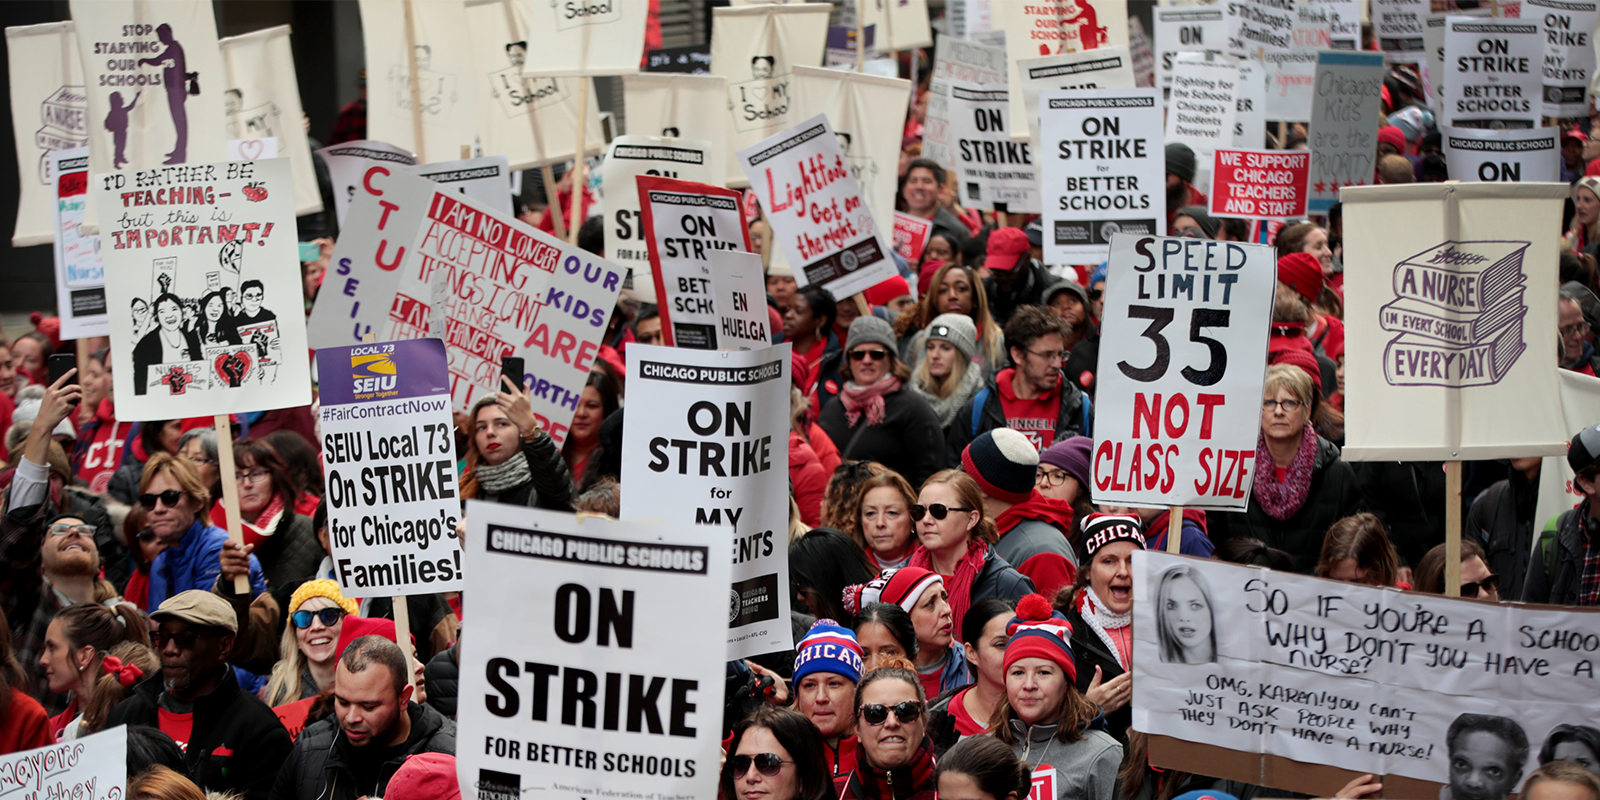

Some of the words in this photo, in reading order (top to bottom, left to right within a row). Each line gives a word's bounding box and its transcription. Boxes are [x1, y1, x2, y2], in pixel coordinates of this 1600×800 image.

[564, 1, 612, 19] School
[1024, 5, 1076, 16] STARVING
[122, 24, 153, 37] STOP
[1035, 19, 1059, 29] OUR
[1544, 13, 1571, 31] ON
[1180, 26, 1203, 45] ON
[1477, 39, 1508, 55] ON
[94, 41, 160, 54] STARVING
[107, 59, 136, 71] OUR
[1457, 57, 1530, 74] STRIKE
[1544, 54, 1566, 68] MY
[99, 73, 162, 87] SCHOOLS
[1463, 85, 1523, 98] BETTER
[509, 79, 559, 106] School
[740, 86, 747, 102] I
[771, 82, 789, 99] MY
[1050, 98, 1085, 108] CHICAGO
[1115, 97, 1154, 107] SCHOOLS
[743, 97, 791, 121] School
[1325, 98, 1361, 122] Kids
[1457, 100, 1531, 113] SCHOOLS
[975, 108, 1003, 132] ON
[1082, 117, 1120, 136] ON
[1058, 139, 1147, 160] STRIKE
[1345, 127, 1371, 149] the
[1450, 138, 1483, 149] CHICAGO
[1484, 141, 1515, 150] PUBLIC
[1516, 139, 1554, 150] SCHOOLS
[615, 145, 649, 158] CHICAGO
[649, 147, 676, 161] PUBLIC
[675, 149, 703, 163] SCHOOLS
[750, 145, 780, 165] CHICAGO
[959, 138, 1033, 166] STRIKE
[1220, 152, 1242, 167] WE
[1246, 153, 1307, 169] SUPPORT
[104, 173, 126, 190] I'D
[136, 165, 216, 188] RATHER
[227, 162, 254, 180] BE
[459, 168, 498, 179] SCHOOLS
[1067, 176, 1139, 191] BETTER
[1233, 169, 1294, 185] CHICAGO
[1478, 162, 1521, 182] ON
[765, 152, 848, 217] Lightfoot
[1228, 183, 1297, 201] TEACHERS
[652, 193, 680, 205] CHICAGO
[680, 195, 705, 206] PUBLIC
[705, 197, 736, 210] SCHOOLS
[811, 197, 842, 225] Get
[844, 195, 861, 213] on
[1059, 194, 1151, 211] SCHOOLS
[1224, 199, 1255, 215] AND
[1258, 201, 1297, 216] STAFF
[117, 211, 154, 229] but
[162, 208, 200, 225] this
[211, 206, 233, 222] is
[681, 214, 717, 237] ON
[112, 222, 275, 251] IMPORTANT!
[443, 201, 478, 229] AM
[480, 211, 504, 242] NO
[506, 229, 562, 274] LONGER
[420, 221, 533, 291] ACCEPTING
[617, 248, 633, 260] FOR
[1133, 237, 1247, 272] SPEED
[564, 255, 620, 293] OUR
[1138, 274, 1238, 305] LIMIT
[1401, 268, 1418, 295] A
[1422, 270, 1476, 308] NURSE
[500, 290, 550, 333] CAN'T
[545, 286, 605, 328] KIDS
[732, 291, 748, 312] EN
[721, 315, 767, 342] HUELGA
[1385, 312, 1398, 325] IN
[1402, 314, 1433, 332] EVERY
[1434, 322, 1468, 342] SCHOOL
[351, 346, 380, 356] LOCAL
[382, 344, 395, 353] 73
[523, 322, 598, 374] ARE
[1117, 304, 1231, 387] 35
[643, 363, 698, 380] CHICAGO
[699, 369, 747, 382] PUBLIC
[748, 363, 779, 381] SCHOOLS
[1395, 349, 1458, 379] EVERY
[1459, 347, 1489, 379] DAY
[353, 375, 397, 394] SEIU
[354, 391, 375, 400] Stronger
[376, 389, 399, 399] Together
[322, 400, 447, 422] #FairContractNow
[687, 401, 752, 437] ON
[1132, 392, 1225, 440] NOT
[325, 431, 362, 465] SEIU
[367, 426, 418, 461] Local
[423, 423, 451, 455] 73
[648, 435, 771, 478] STRIKE
[1094, 440, 1180, 494] CLASS
[1194, 447, 1255, 499] SIZE
[329, 469, 357, 509] On
[362, 460, 455, 507] STRIKE
[710, 486, 733, 500] for
[332, 518, 355, 549] for
[361, 509, 458, 550] Chicago's
[695, 507, 744, 534] MY
[490, 529, 565, 558] CHICAGO
[565, 537, 626, 565] PUBLIC
[626, 545, 706, 571] SCHOOLS
[338, 550, 462, 588] Families!
[741, 595, 769, 607] TEACHERS
[1244, 578, 1289, 616] SO
[1317, 594, 1344, 618] IF
[1363, 602, 1449, 636] YOU'RE
[1466, 619, 1487, 642] A
[554, 582, 635, 649] ON
[1265, 621, 1328, 655] WHY
[1344, 632, 1416, 666] DON'T
[1425, 642, 1468, 669] YOU
[1483, 652, 1551, 677] HAVE
[1573, 659, 1595, 679] A
[1288, 648, 1373, 675] NURSE?
[484, 657, 699, 739] STRIKE
[1206, 674, 1252, 698] OMG,
[1368, 702, 1417, 721] CAN'T
[1185, 689, 1226, 710] JUST
[1239, 702, 1279, 721] ASK
[1297, 709, 1357, 730] PEOPLE
[1369, 721, 1411, 739] WHY
[1178, 708, 1216, 726] THEY
[1227, 716, 1279, 736] DON'T
[1292, 727, 1335, 745] HAVE
[1346, 736, 1361, 751] A
[1368, 741, 1435, 761] NURSE!
[485, 736, 521, 760] FOR
[526, 741, 598, 772] BETTER
[602, 752, 697, 779] SCHOOLS
